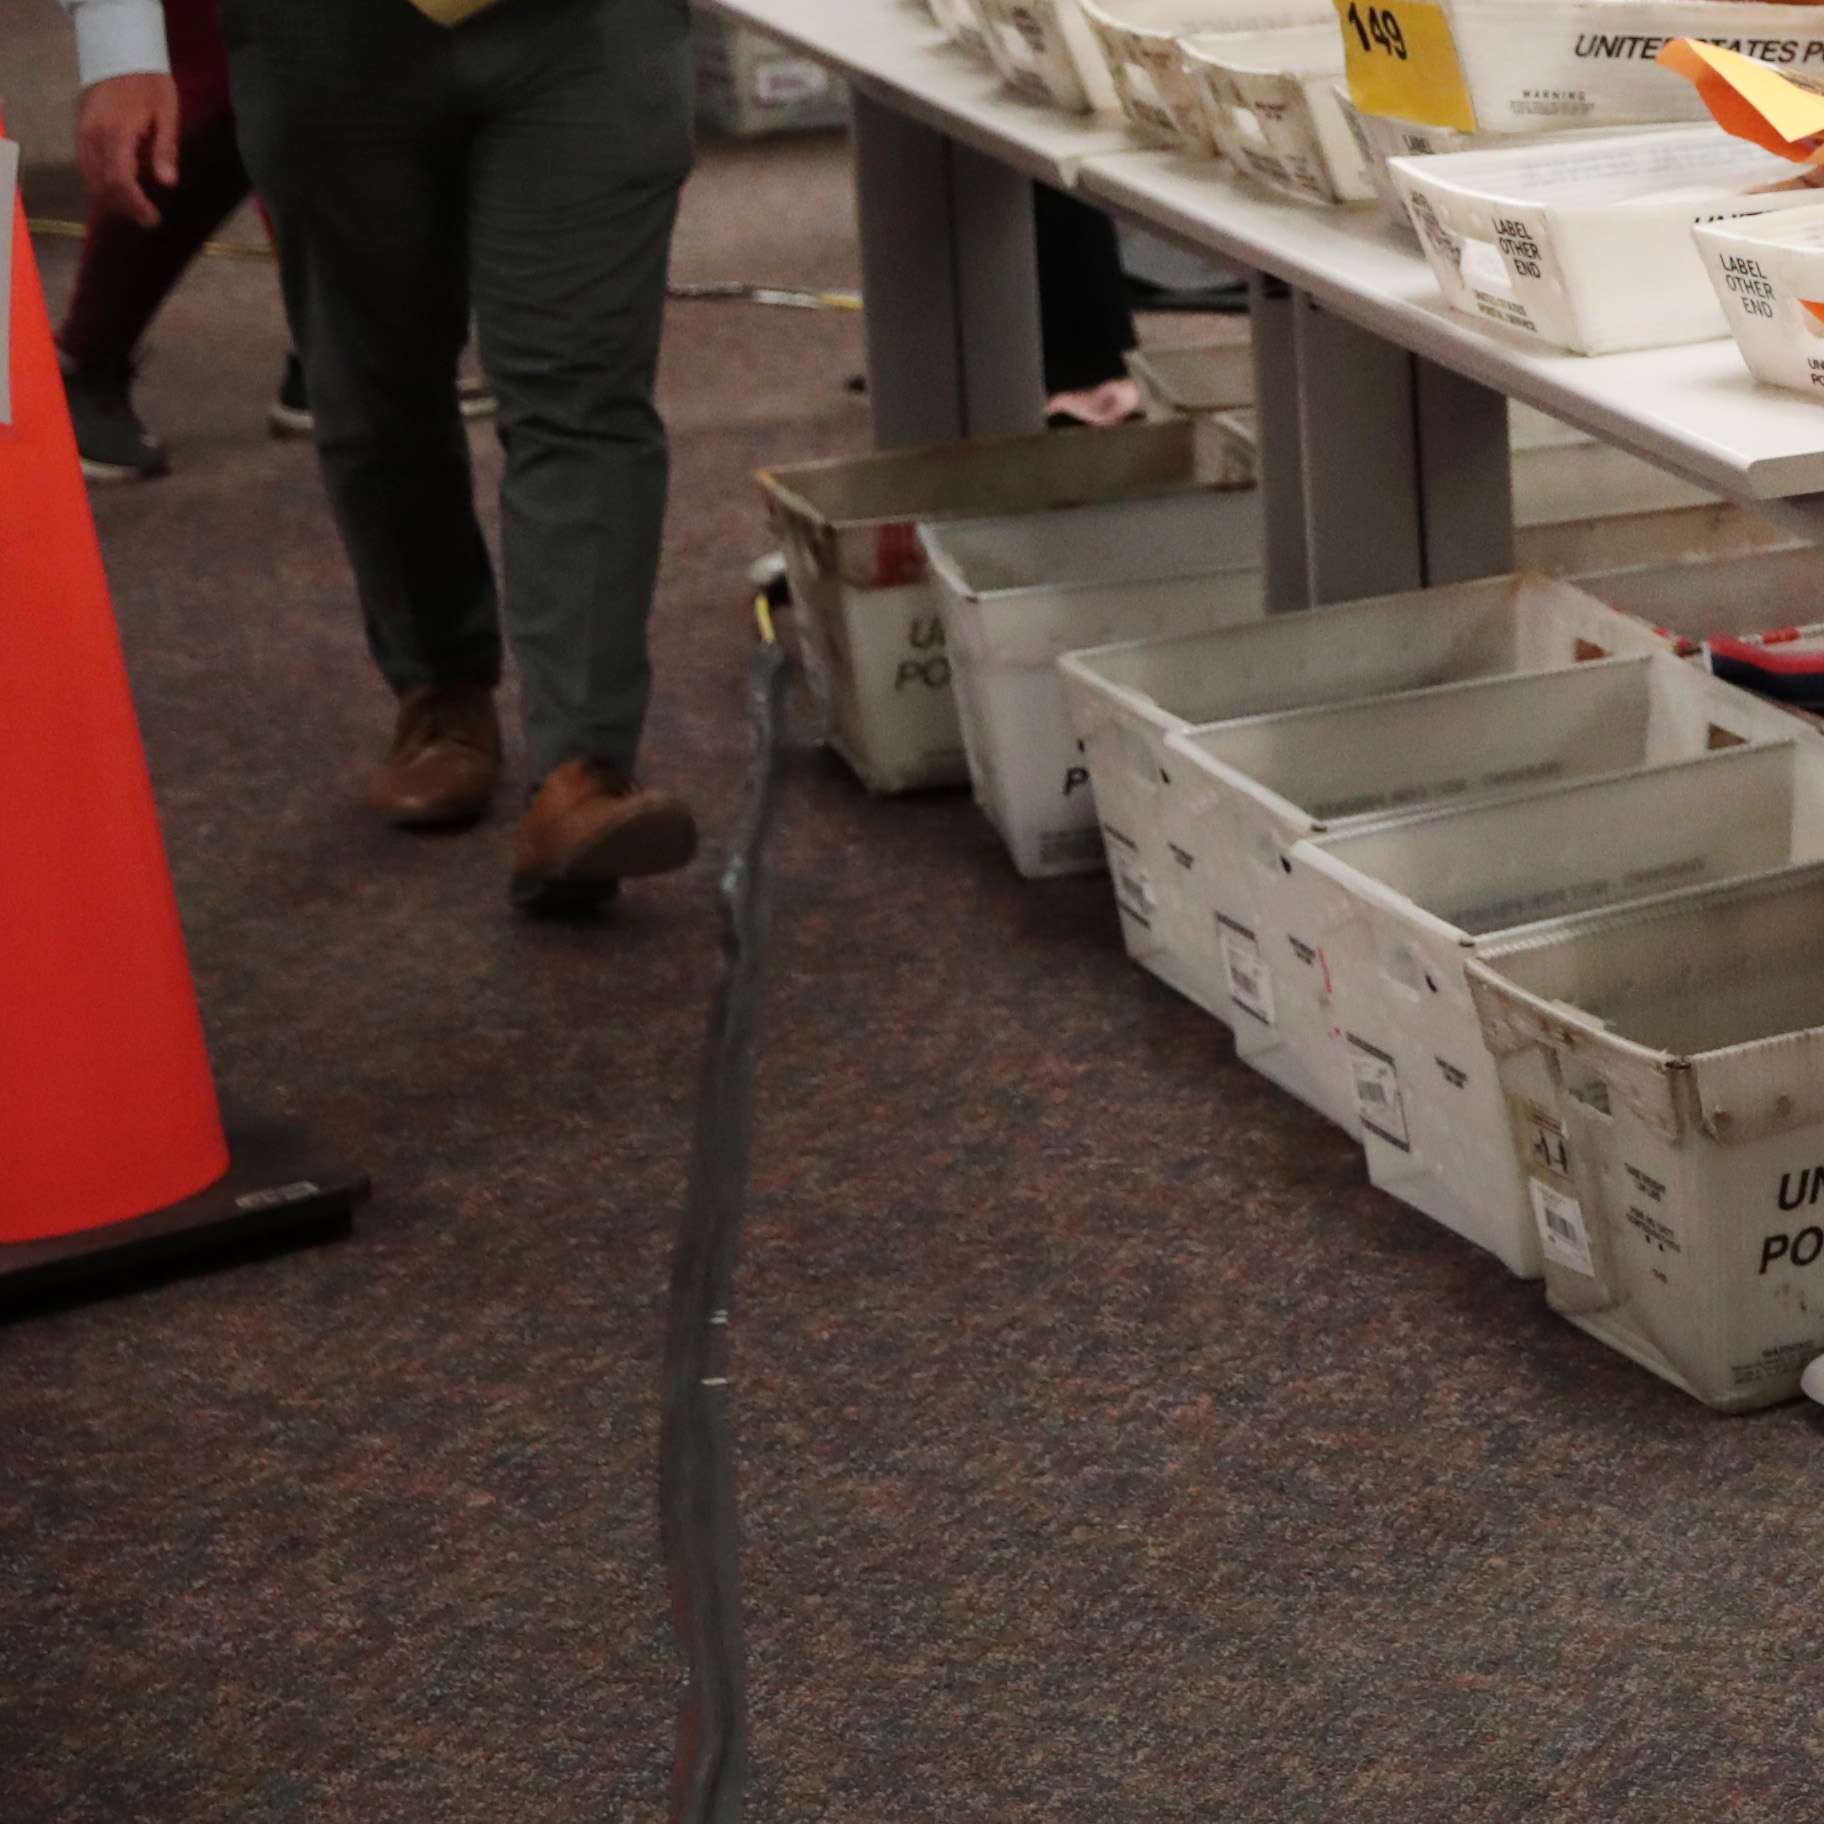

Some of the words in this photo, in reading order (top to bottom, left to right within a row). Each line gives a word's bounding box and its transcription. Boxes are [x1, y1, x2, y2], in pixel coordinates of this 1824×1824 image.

[1347, 1, 1408, 60] 149
[1574, 33, 1676, 60] UNITE
[1491, 217, 1533, 240] LABEL
[1499, 237, 1541, 261] OTHER
[1514, 259, 1541, 279] END
[1719, 253, 1768, 280] LABEL
[1726, 274, 1776, 300] OTHER
[1741, 296, 1773, 318] END
